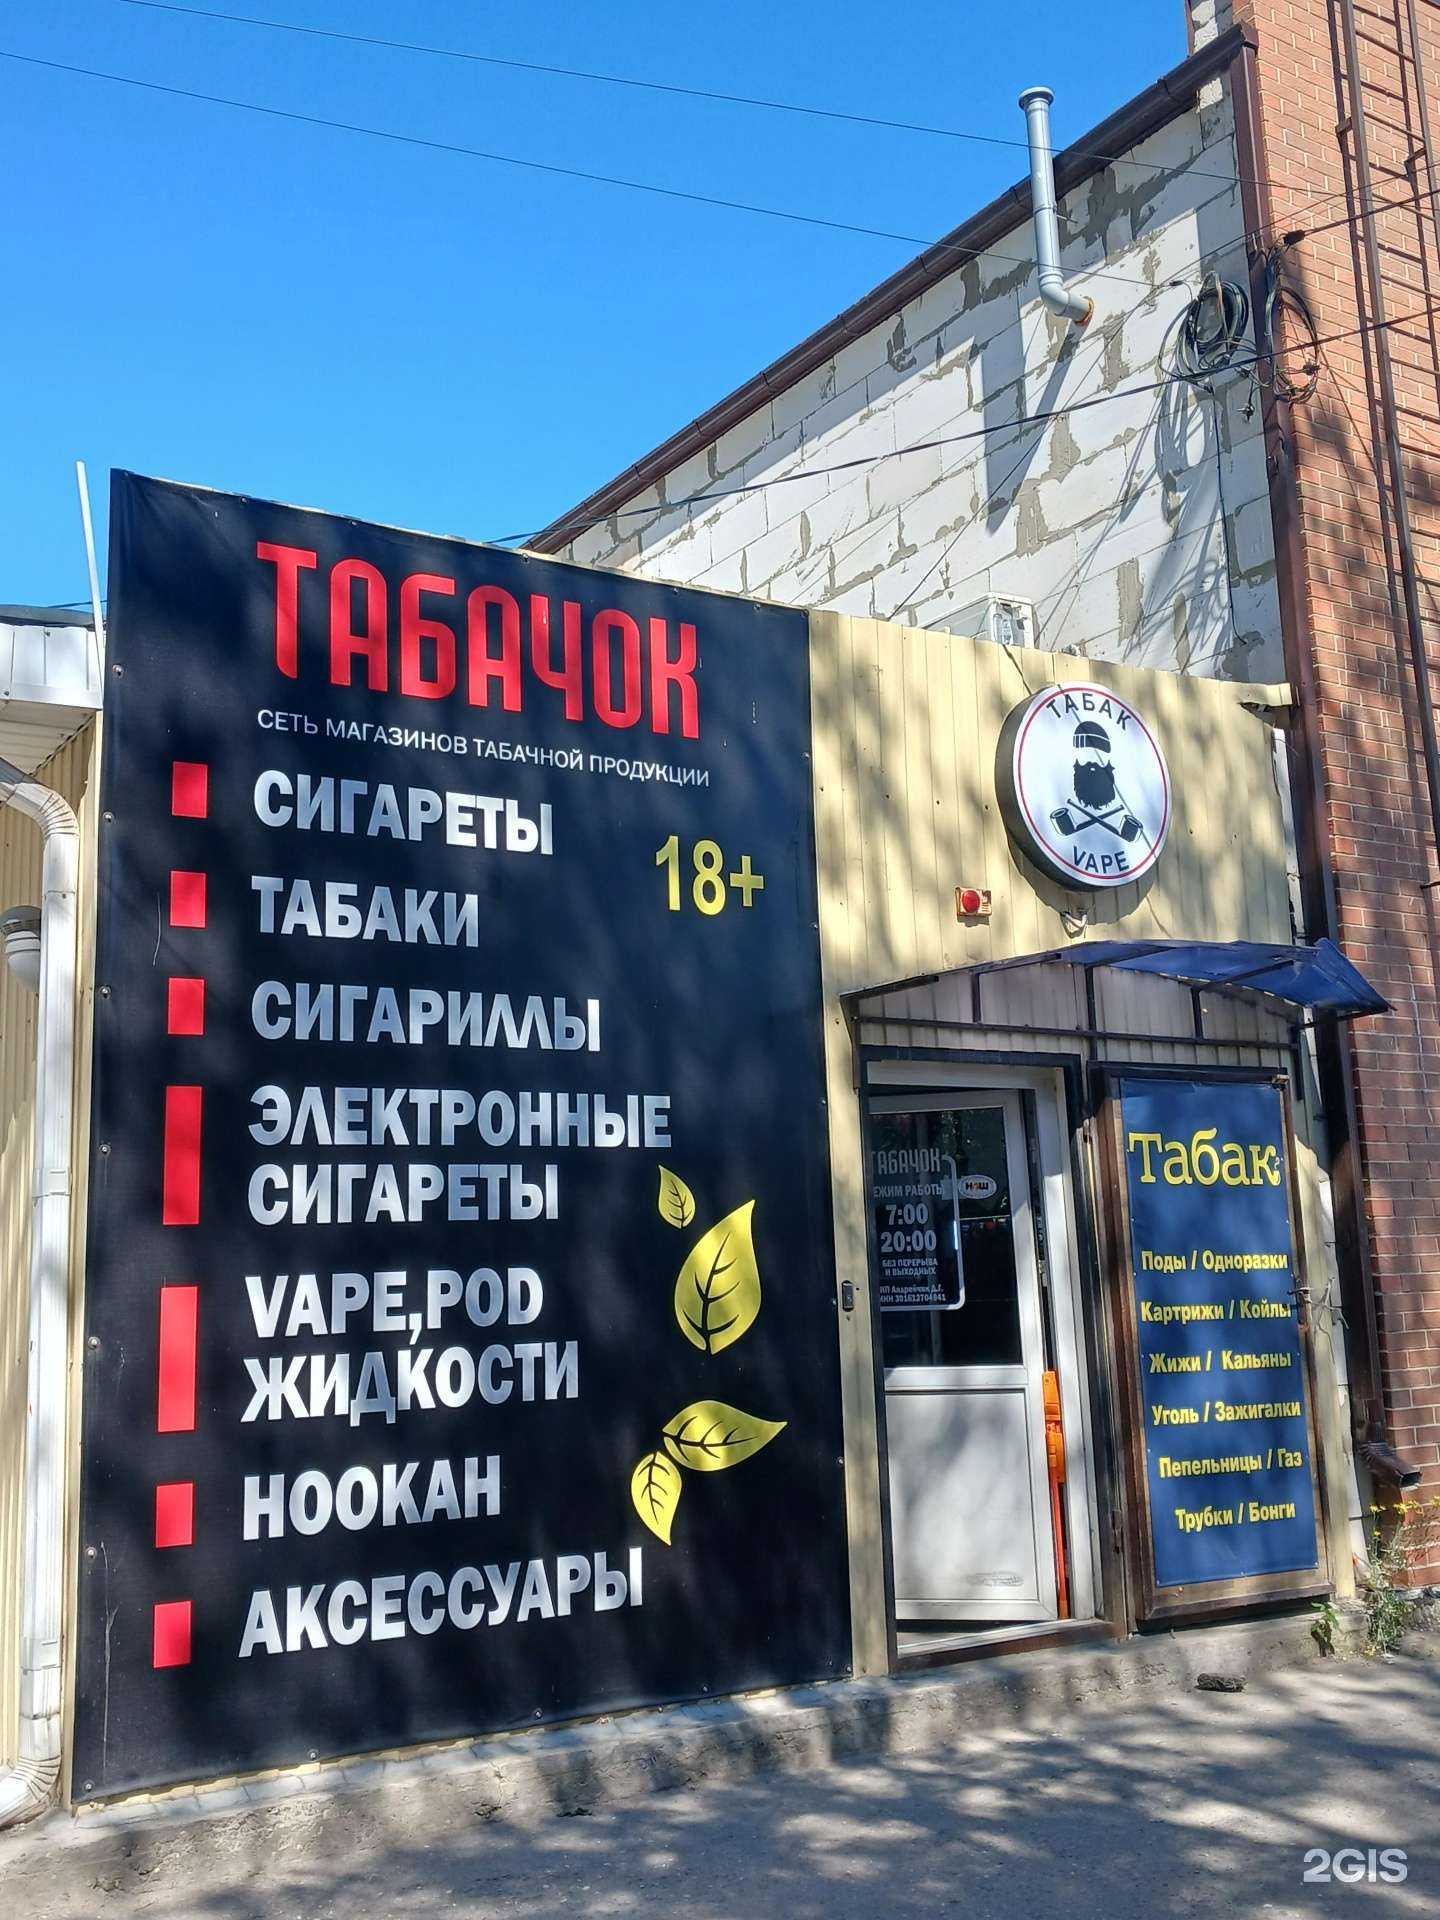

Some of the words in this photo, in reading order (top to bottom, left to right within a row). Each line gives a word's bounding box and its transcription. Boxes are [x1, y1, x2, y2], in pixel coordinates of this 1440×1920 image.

[256, 541, 700, 740] ТАБАЧОК
[1046, 692, 1133, 731] ТАБАК
[257, 709, 319, 735] СЕТЬ
[326, 718, 468, 755] МАГАЗИНОВ
[473, 738, 583, 771] ТАБАЧНОЙ
[590, 756, 709, 787] ПРОДУКЦИИ
[253, 769, 554, 855] СИГАРЕТЫ
[655, 835, 764, 917] 18+
[1072, 846, 1130, 874] VAPE
[251, 875, 479, 947] ТАБАКИ
[251, 980, 601, 1052] СИГАРИЛЛЫ
[248, 1085, 672, 1148] ЭЛЕКТРОННЫЕ
[1128, 1127, 1281, 1187] Табак
[247, 1163, 559, 1226] СИГАРЕТЫ
[873, 1184, 903, 1199] ЕЖИМ
[886, 1203, 929, 1226] 7:00
[880, 1230, 937, 1253] 20:00
[1141, 1250, 1186, 1272] Поды
[1191, 1250, 1198, 1271] /
[1202, 1250, 1288, 1273] Одноразки
[244, 1267, 544, 1346] VAPE,POD
[1141, 1301, 1224, 1324] Картрижи
[1229, 1300, 1235, 1319] /
[1240, 1298, 1291, 1319] Койлы
[240, 1340, 579, 1427] ЖИДКОСТИ
[1150, 1353, 1201, 1373] Жижи
[1206, 1350, 1212, 1371] /
[1222, 1350, 1291, 1371] Кальяны
[1152, 1405, 1199, 1426] Уголь
[1203, 1401, 1210, 1423] /
[1215, 1401, 1301, 1422] Зажигалки
[1159, 1453, 1262, 1478] Пепельницы
[1266, 1449, 1273, 1469] /
[1277, 1448, 1302, 1468] Газ
[243, 1455, 501, 1541] HOOKAH
[1175, 1506, 1233, 1533] Трубки
[1238, 1503, 1244, 1524] /
[1249, 1502, 1296, 1523] Бонги
[238, 1547, 643, 1659] АКСЕССУАРЫ
